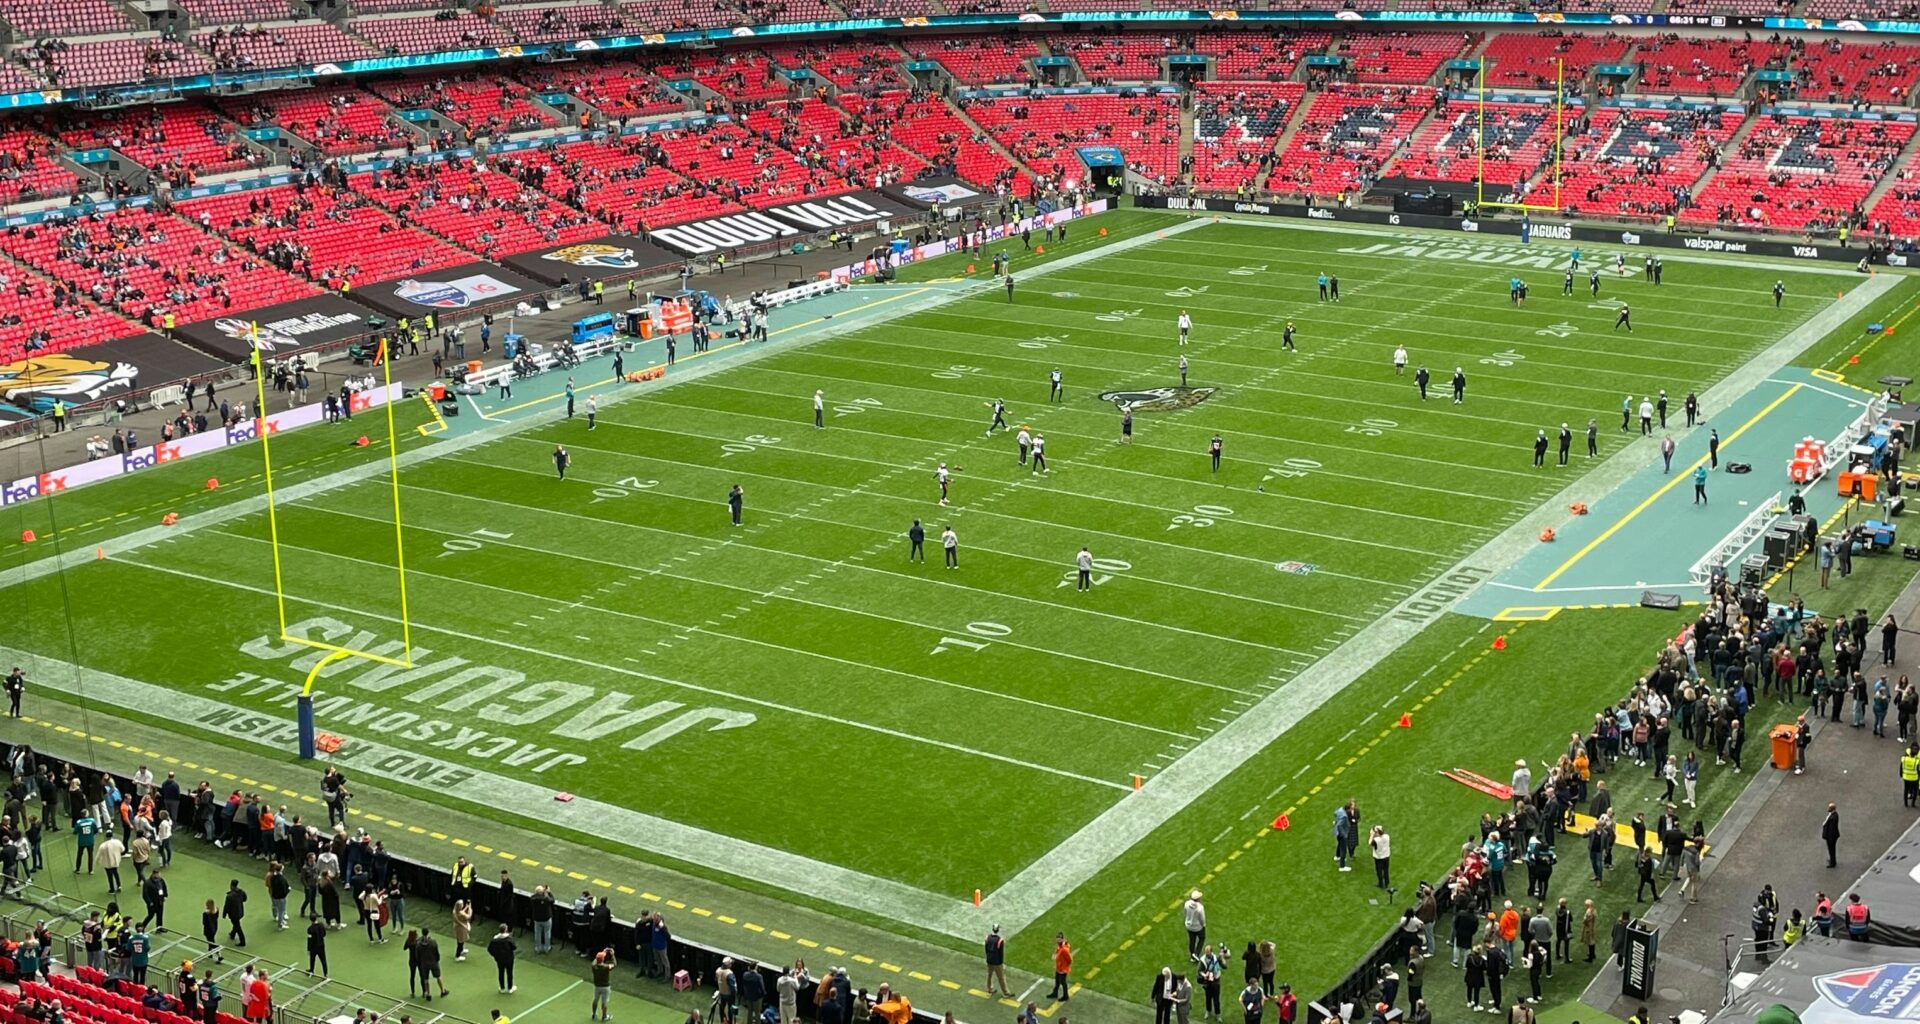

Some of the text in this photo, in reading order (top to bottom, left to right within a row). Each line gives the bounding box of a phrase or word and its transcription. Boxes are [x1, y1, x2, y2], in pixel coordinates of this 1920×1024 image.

[769, 21, 816, 33] BRONCOS
[834, 18, 883, 30] JAGUARS
[1060, 11, 1115, 21] BRONCOS
[1136, 10, 1190, 21] JAGUARS
[1379, 11, 1436, 21] BRONCOS
[1457, 12, 1514, 22] JAGUARS
[352, 54, 410, 72] BRONCOS
[431, 48, 485, 66] JAGUARS
[1389, 213, 1400, 225] IG
[1528, 223, 1572, 240] JAGUARS
[1684, 236, 1747, 252] valspar paint
[1792, 246, 1818, 258] VISA
[1337, 243, 1643, 277] JAGUARS
[411, 287, 460, 301] LONDON
[277, 312, 362, 337] FOUNDATION
[1535, 324, 1580, 338] 20
[1479, 351, 1526, 367] 30
[833, 397, 884, 414] 40
[226, 416, 280, 446] FedEx
[1344, 418, 1399, 437] 50
[721, 434, 782, 453] 30
[123, 442, 182, 473] FedEx
[1268, 458, 1323, 478] 40
[2, 472, 68, 504] FedEx
[591, 476, 661, 499] 20
[1170, 504, 1235, 529] 30
[442, 527, 514, 551] 10
[1391, 565, 1493, 624] LONDON
[939, 621, 1013, 652] 10
[239, 615, 758, 751] JAGUARS
[198, 707, 375, 762] RCISM
[372, 754, 477, 789] END
